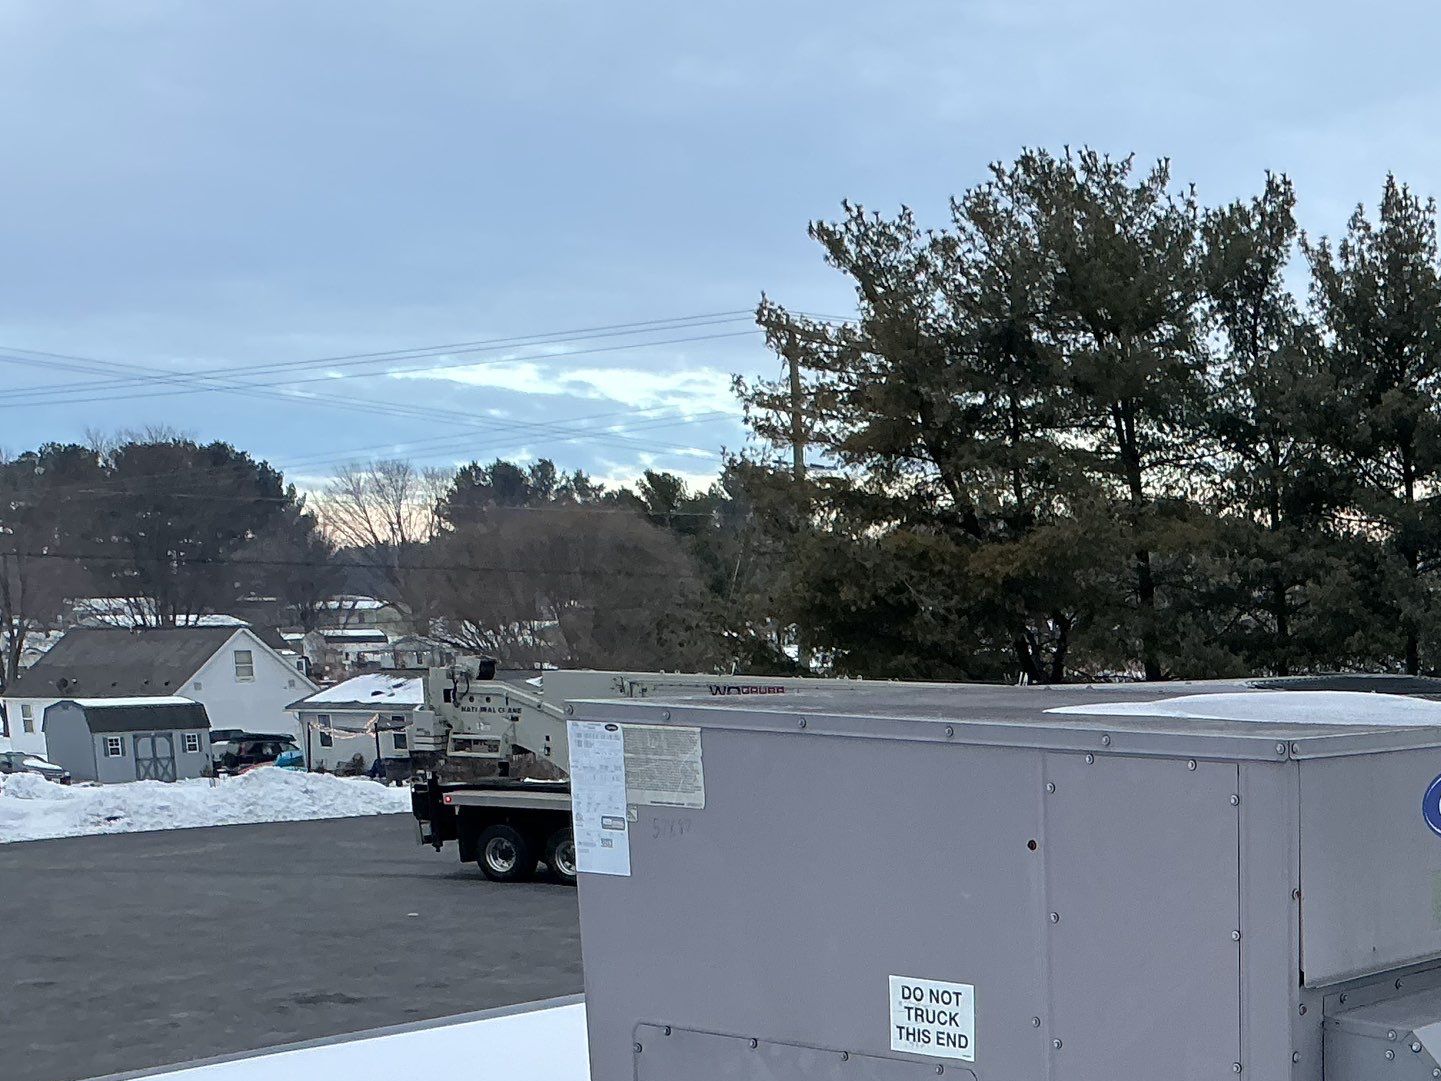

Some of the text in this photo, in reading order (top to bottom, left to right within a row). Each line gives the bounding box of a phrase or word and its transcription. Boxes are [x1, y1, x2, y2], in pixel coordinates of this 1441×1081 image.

[901, 985, 962, 1007] DO NOT
[904, 1005, 960, 1028] TRUCK
[896, 1025, 969, 1049] THIS END
